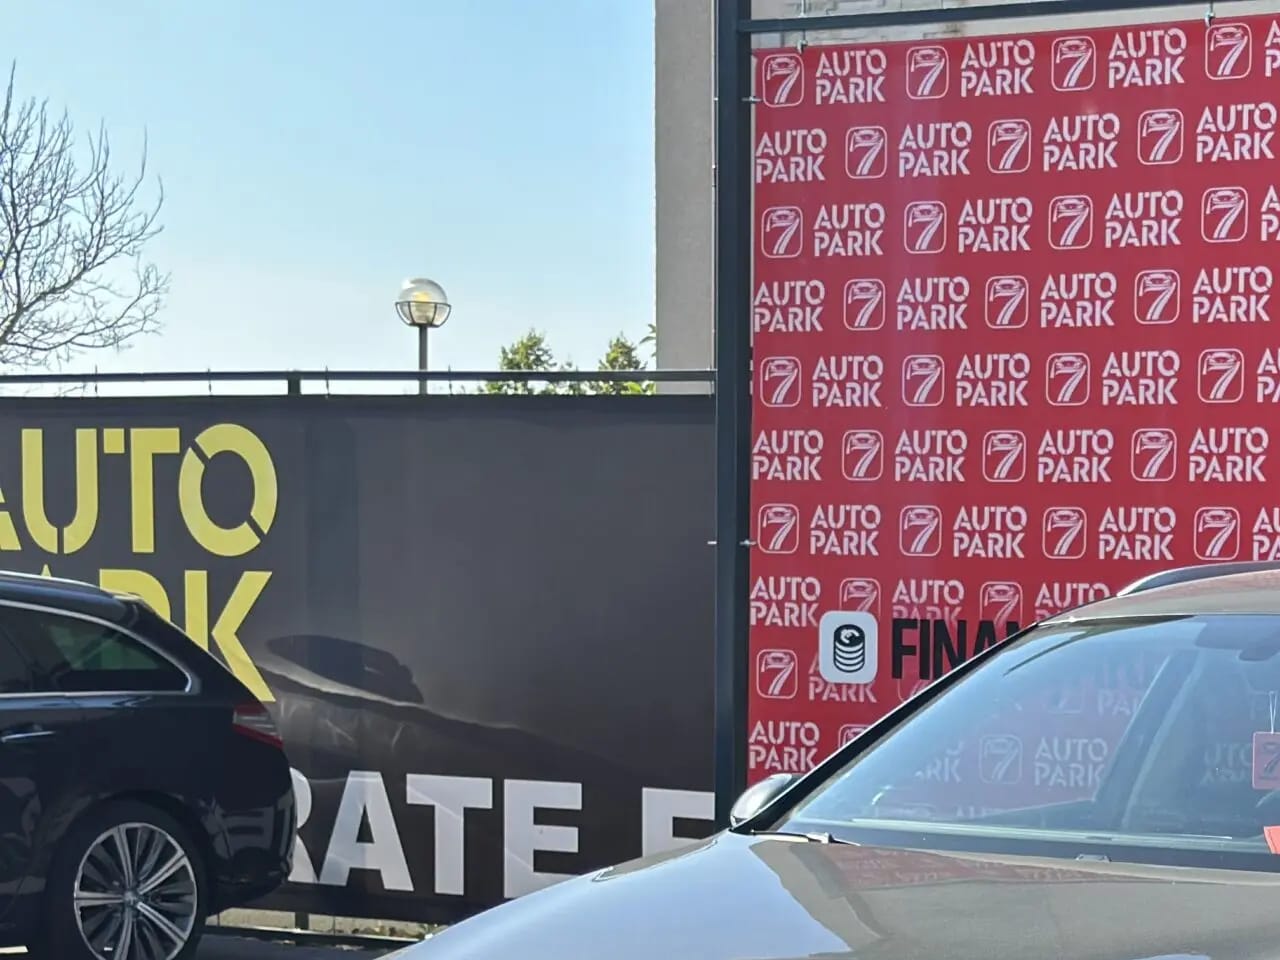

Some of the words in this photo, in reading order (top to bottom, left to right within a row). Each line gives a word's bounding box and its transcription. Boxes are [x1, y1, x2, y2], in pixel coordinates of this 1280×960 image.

[960, 39, 1035, 69] AUTO
[1108, 27, 1186, 60] AUTO
[815, 49, 886, 77] AUTO
[1108, 55, 1184, 88] PARK
[815, 75, 885, 105] PARK
[960, 65, 1034, 97] PARK
[1042, 112, 1121, 145] AUTO
[1195, 101, 1277, 134] AUTO
[755, 127, 827, 156] AUTO
[897, 120, 972, 150] AUTO
[1195, 130, 1275, 162] PARK
[755, 154, 825, 183] PARK
[898, 147, 970, 177] PARK
[1042, 140, 1118, 172] PARK
[812, 202, 885, 230] AUTO
[957, 196, 1033, 225] AUTO
[1104, 188, 1183, 220] AUTO
[813, 228, 883, 256] PARK
[957, 223, 1031, 253] PARK
[1104, 217, 1181, 248] PARK
[753, 279, 826, 307] AUTO
[895, 275, 969, 303] AUTO
[1039, 271, 1117, 300] AUTO
[1191, 265, 1273, 295] AUTO
[753, 305, 823, 332] PARK
[896, 303, 968, 330] PARK
[1040, 298, 1114, 328] PARK
[1192, 293, 1270, 323] PARK
[811, 354, 883, 381] AUTO
[955, 352, 1030, 379] AUTO
[1101, 349, 1180, 378] AUTO
[812, 381, 881, 407] PARK
[955, 379, 1028, 406] PARK
[1101, 376, 1178, 405] PARK
[751, 429, 824, 454] AUTO
[894, 428, 967, 455] AUTO
[1037, 428, 1114, 455] AUTO
[1188, 425, 1269, 454] AUTO
[751, 454, 821, 481] PARK
[894, 455, 965, 482] PARK
[1037, 454, 1112, 483] PARK
[1188, 453, 1266, 482] PARK
[809, 503, 881, 529] AUTO
[952, 505, 1027, 531] AUTO
[1097, 505, 1176, 533] AUTO
[809, 529, 879, 556] PARK
[952, 531, 1025, 558] PARK
[1098, 533, 1173, 560] PARK
[749, 575, 821, 601] AUTO
[891, 578, 964, 605] AUTO
[1034, 581, 1111, 607] AUTO
[749, 600, 818, 626] PARK
[808, 677, 878, 703] PARK
[748, 719, 819, 746] AUTO
[748, 744, 817, 772] PARK
